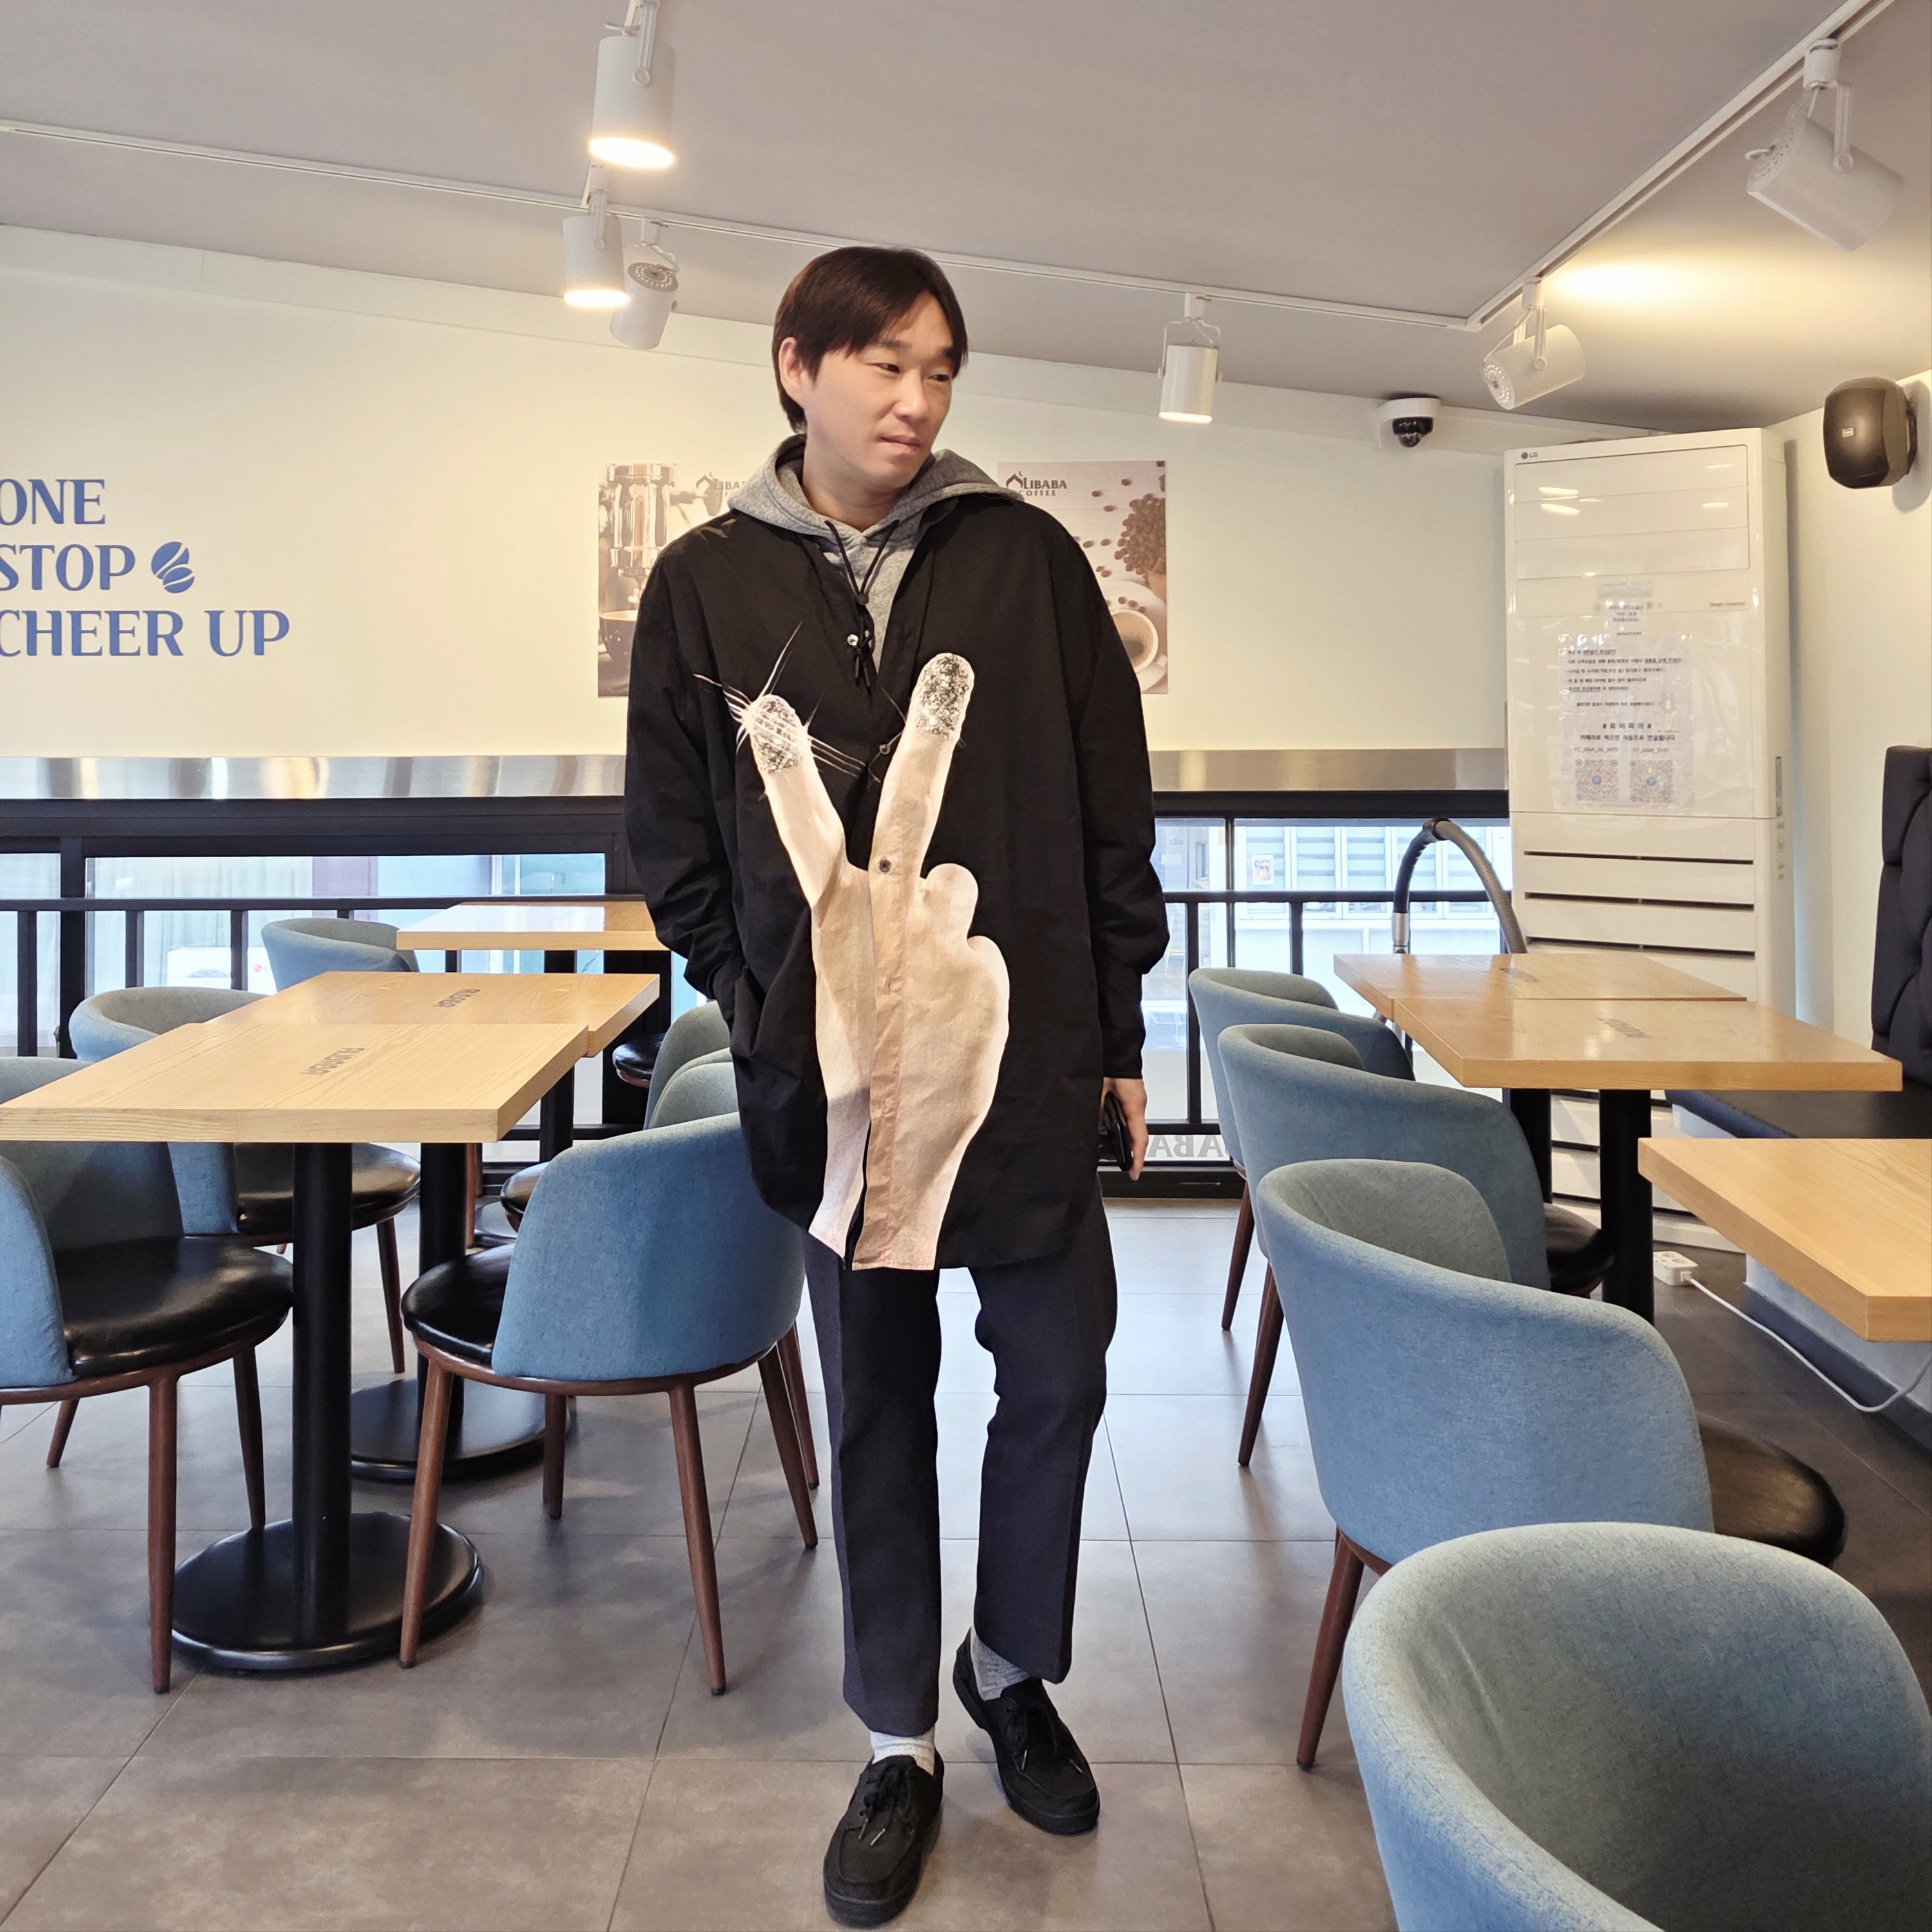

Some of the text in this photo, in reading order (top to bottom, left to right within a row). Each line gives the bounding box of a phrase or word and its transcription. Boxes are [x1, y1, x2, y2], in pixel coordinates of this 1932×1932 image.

[0, 478, 106, 526] ONE
[0, 544, 136, 591] STOP
[0, 609, 290, 657] CHEER UP
